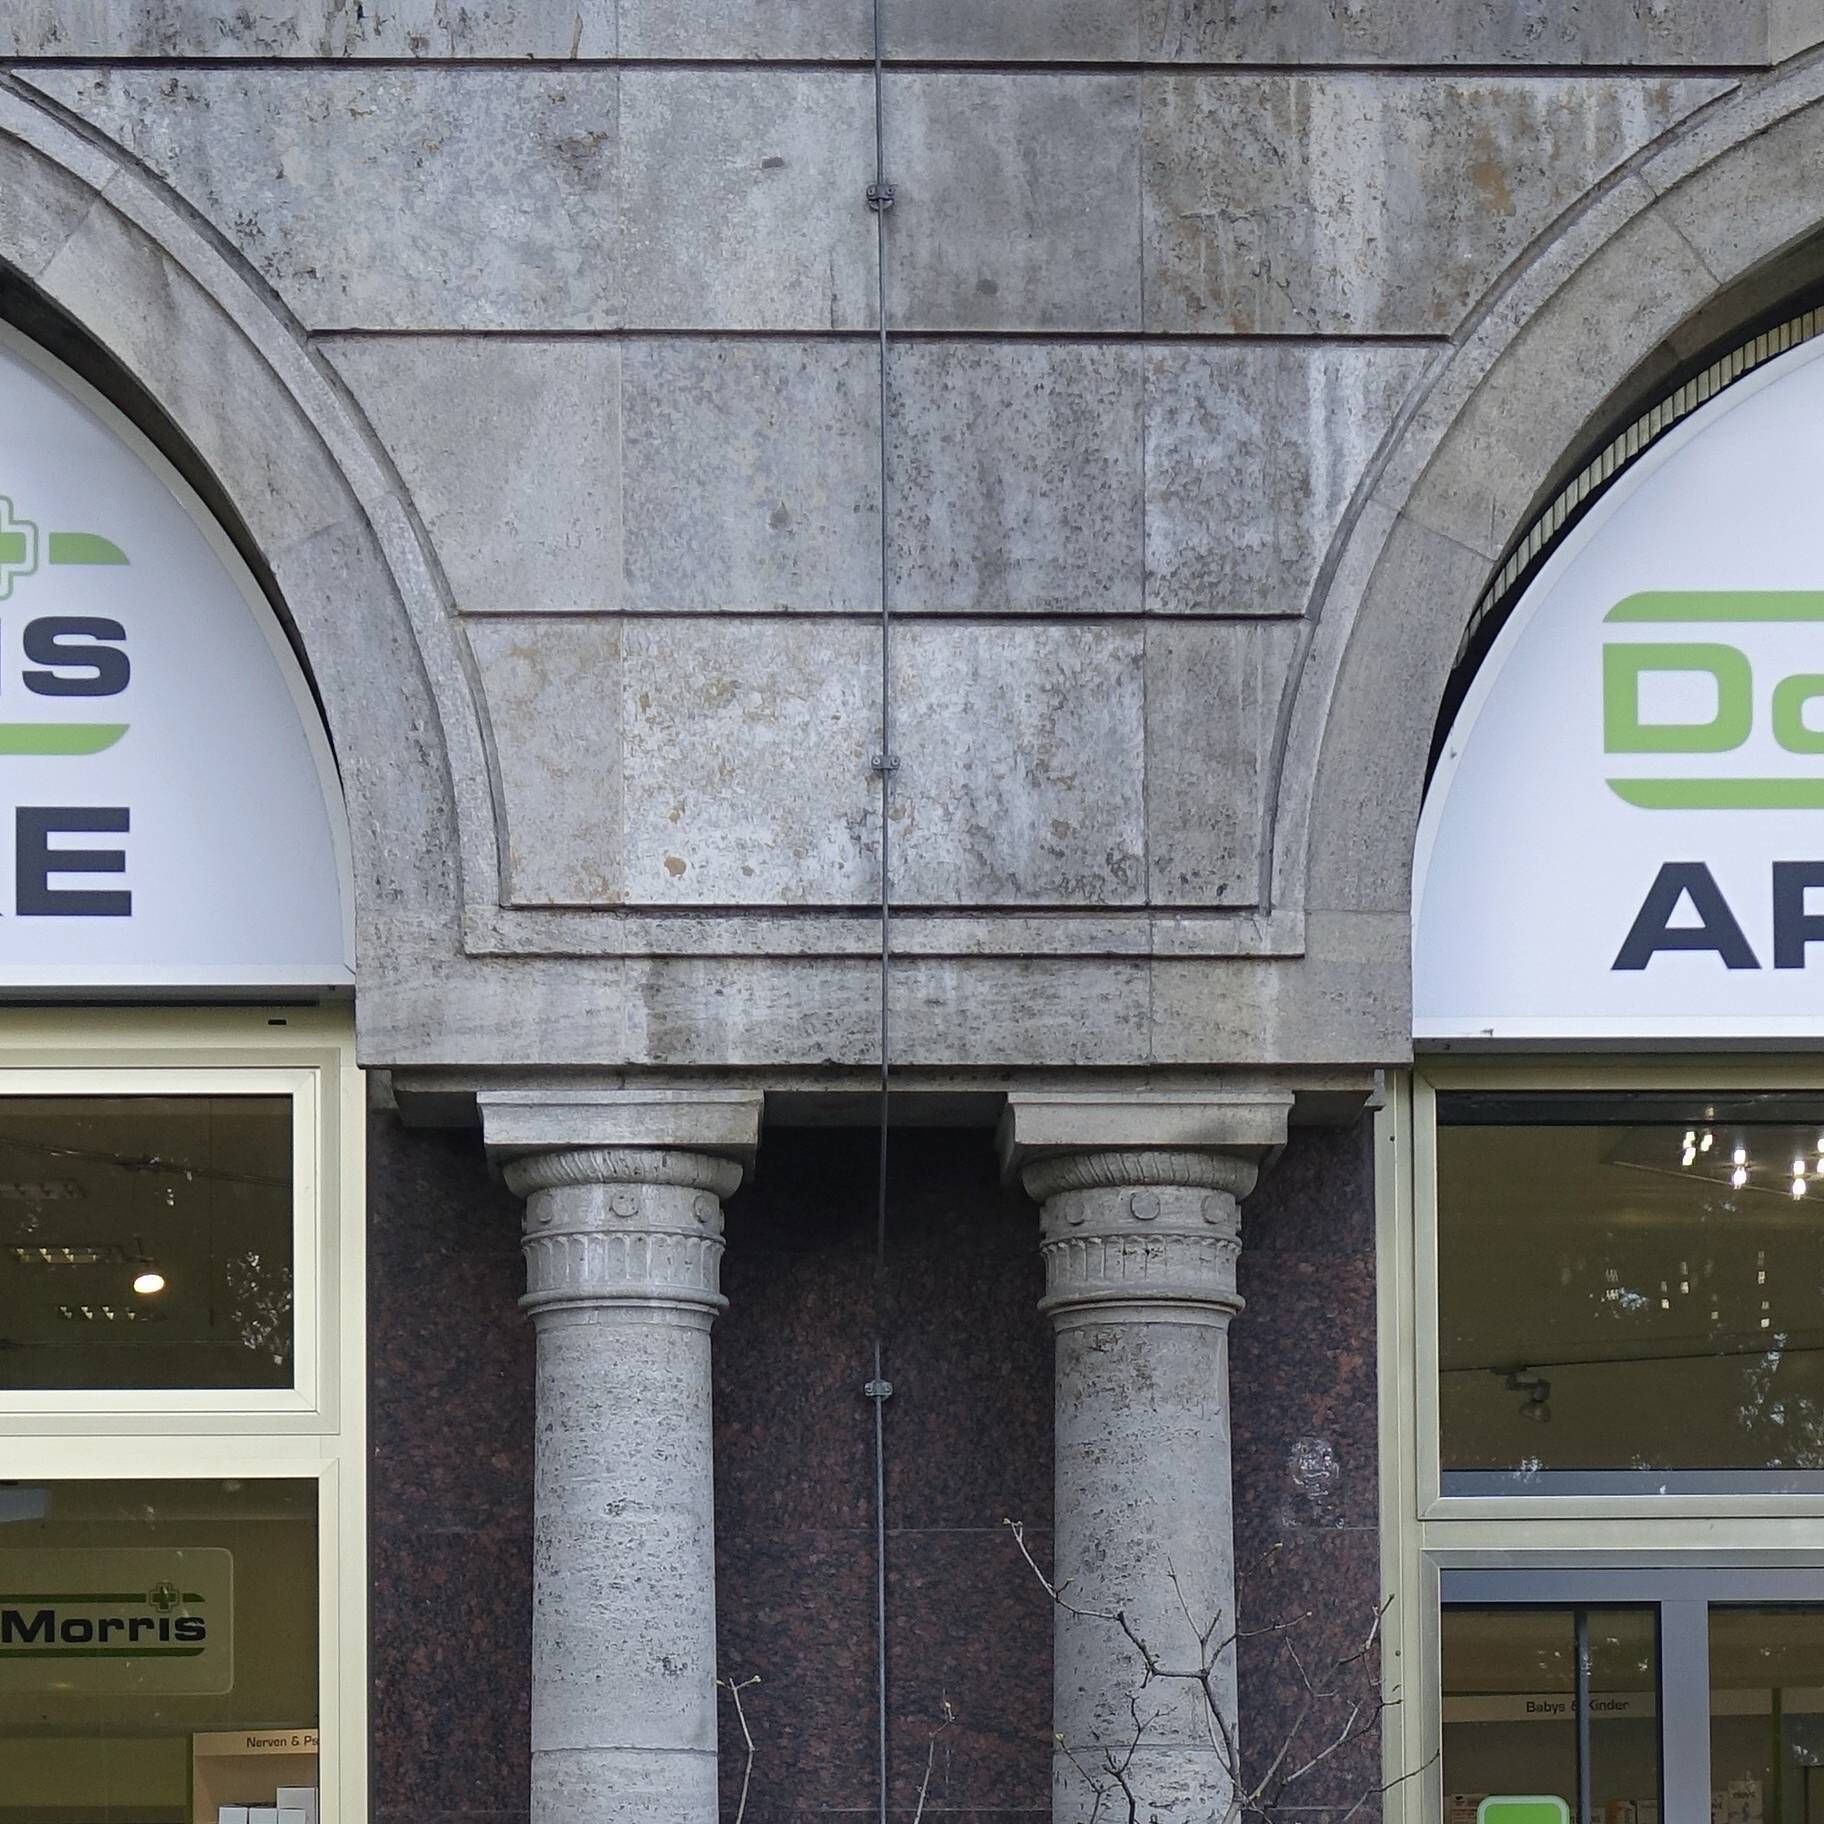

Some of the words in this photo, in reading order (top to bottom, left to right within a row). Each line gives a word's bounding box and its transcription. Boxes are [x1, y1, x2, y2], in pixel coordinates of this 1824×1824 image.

[1526, 1700, 1565, 1715] Babys
[1588, 1699, 1629, 1712] Kinder
[246, 1736, 287, 1748] Nerven
[291, 1735, 300, 1746] &
